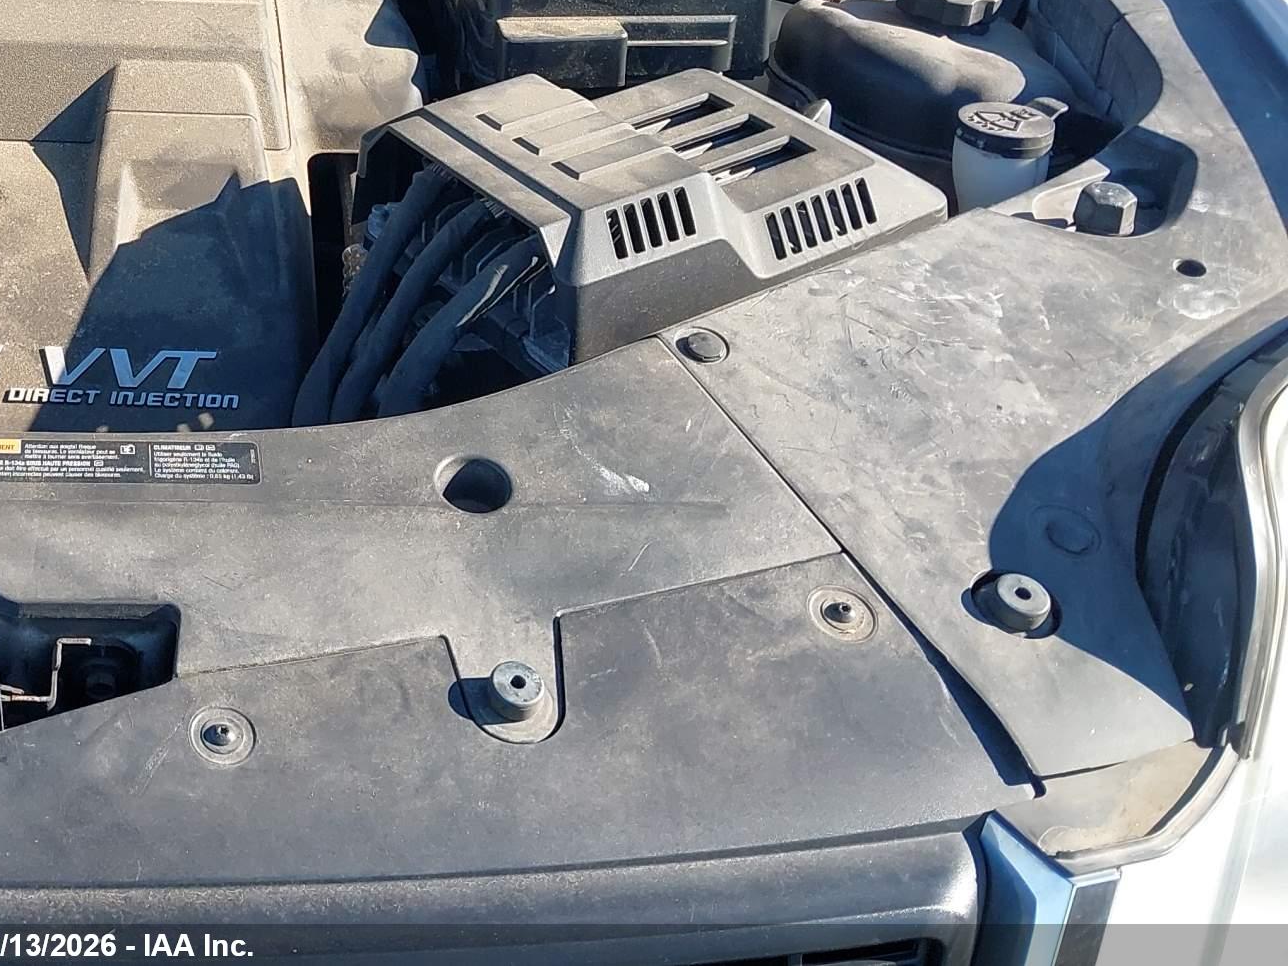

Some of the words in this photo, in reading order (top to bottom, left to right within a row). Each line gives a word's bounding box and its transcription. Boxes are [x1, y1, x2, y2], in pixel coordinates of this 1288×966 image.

[40, 345, 217, 390] VVT
[2, 388, 101, 404] DIRECT
[109, 391, 239, 409] INJECTION
